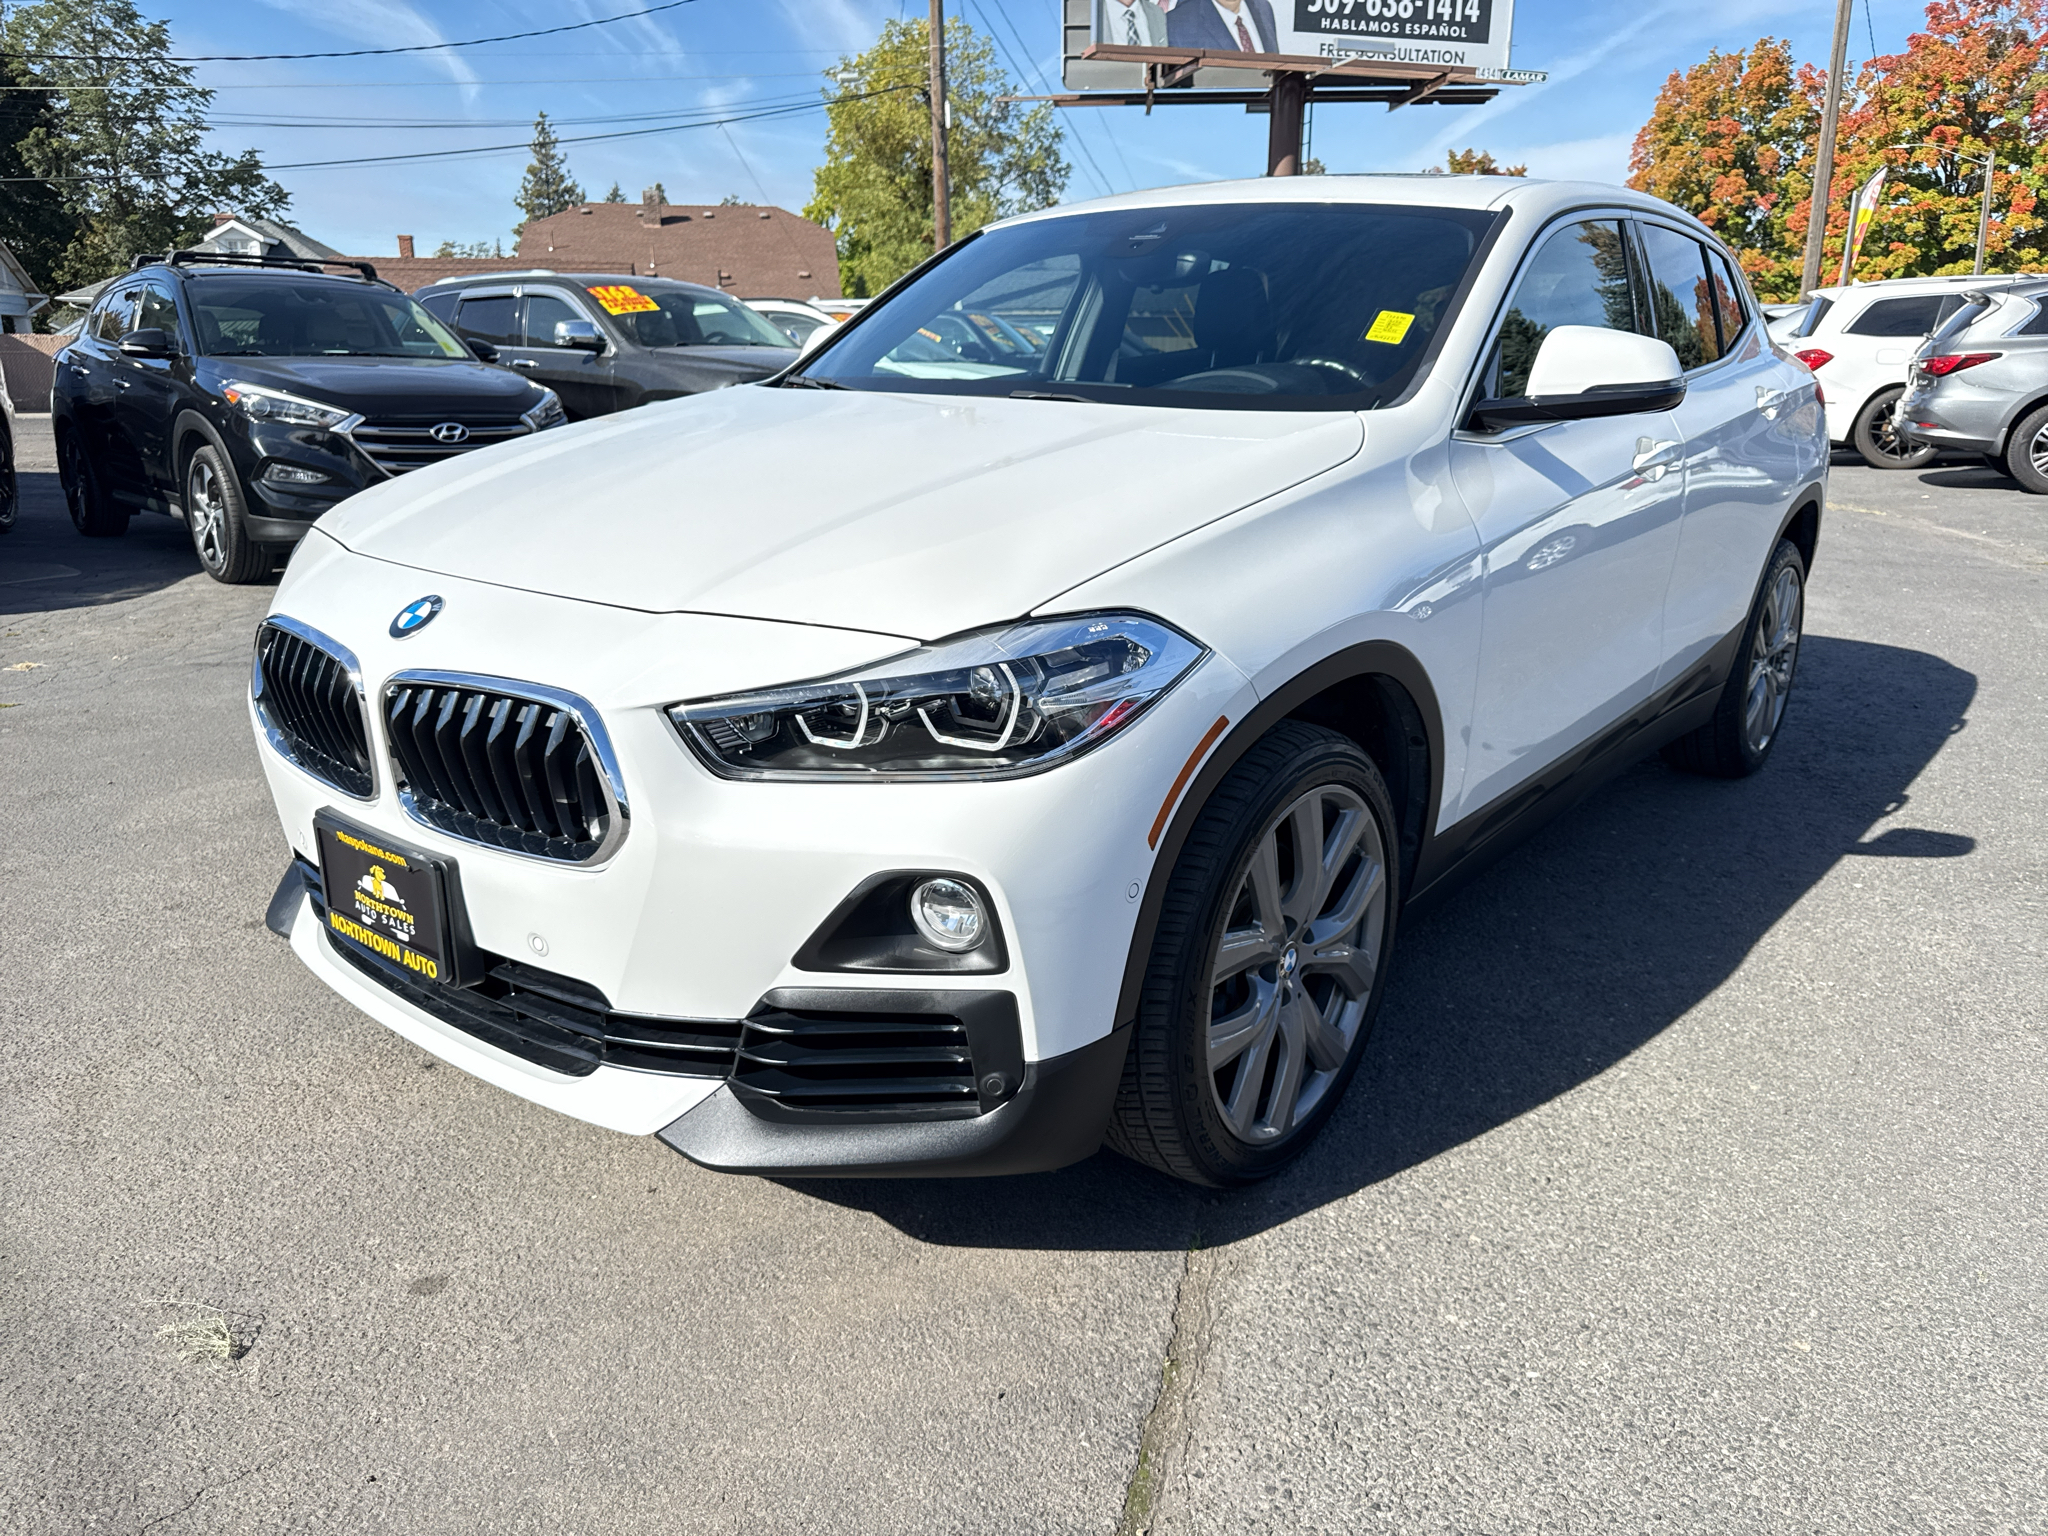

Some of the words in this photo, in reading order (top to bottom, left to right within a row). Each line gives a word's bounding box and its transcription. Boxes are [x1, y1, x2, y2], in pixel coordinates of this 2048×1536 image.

[1320, 17, 1400, 33] HABLAMOS
[1404, 23, 1468, 38] ESPAÑOL
[1506, 71, 1544, 82] LAMAR
[354, 890, 415, 925] NORTHTOWN
[355, 900, 378, 920] AUTO
[381, 914, 416, 936] SALES
[330, 911, 401, 962] NORTHTOWN
[402, 949, 438, 979] AUTO
[1191, 1105, 1231, 1168] ENERAL
